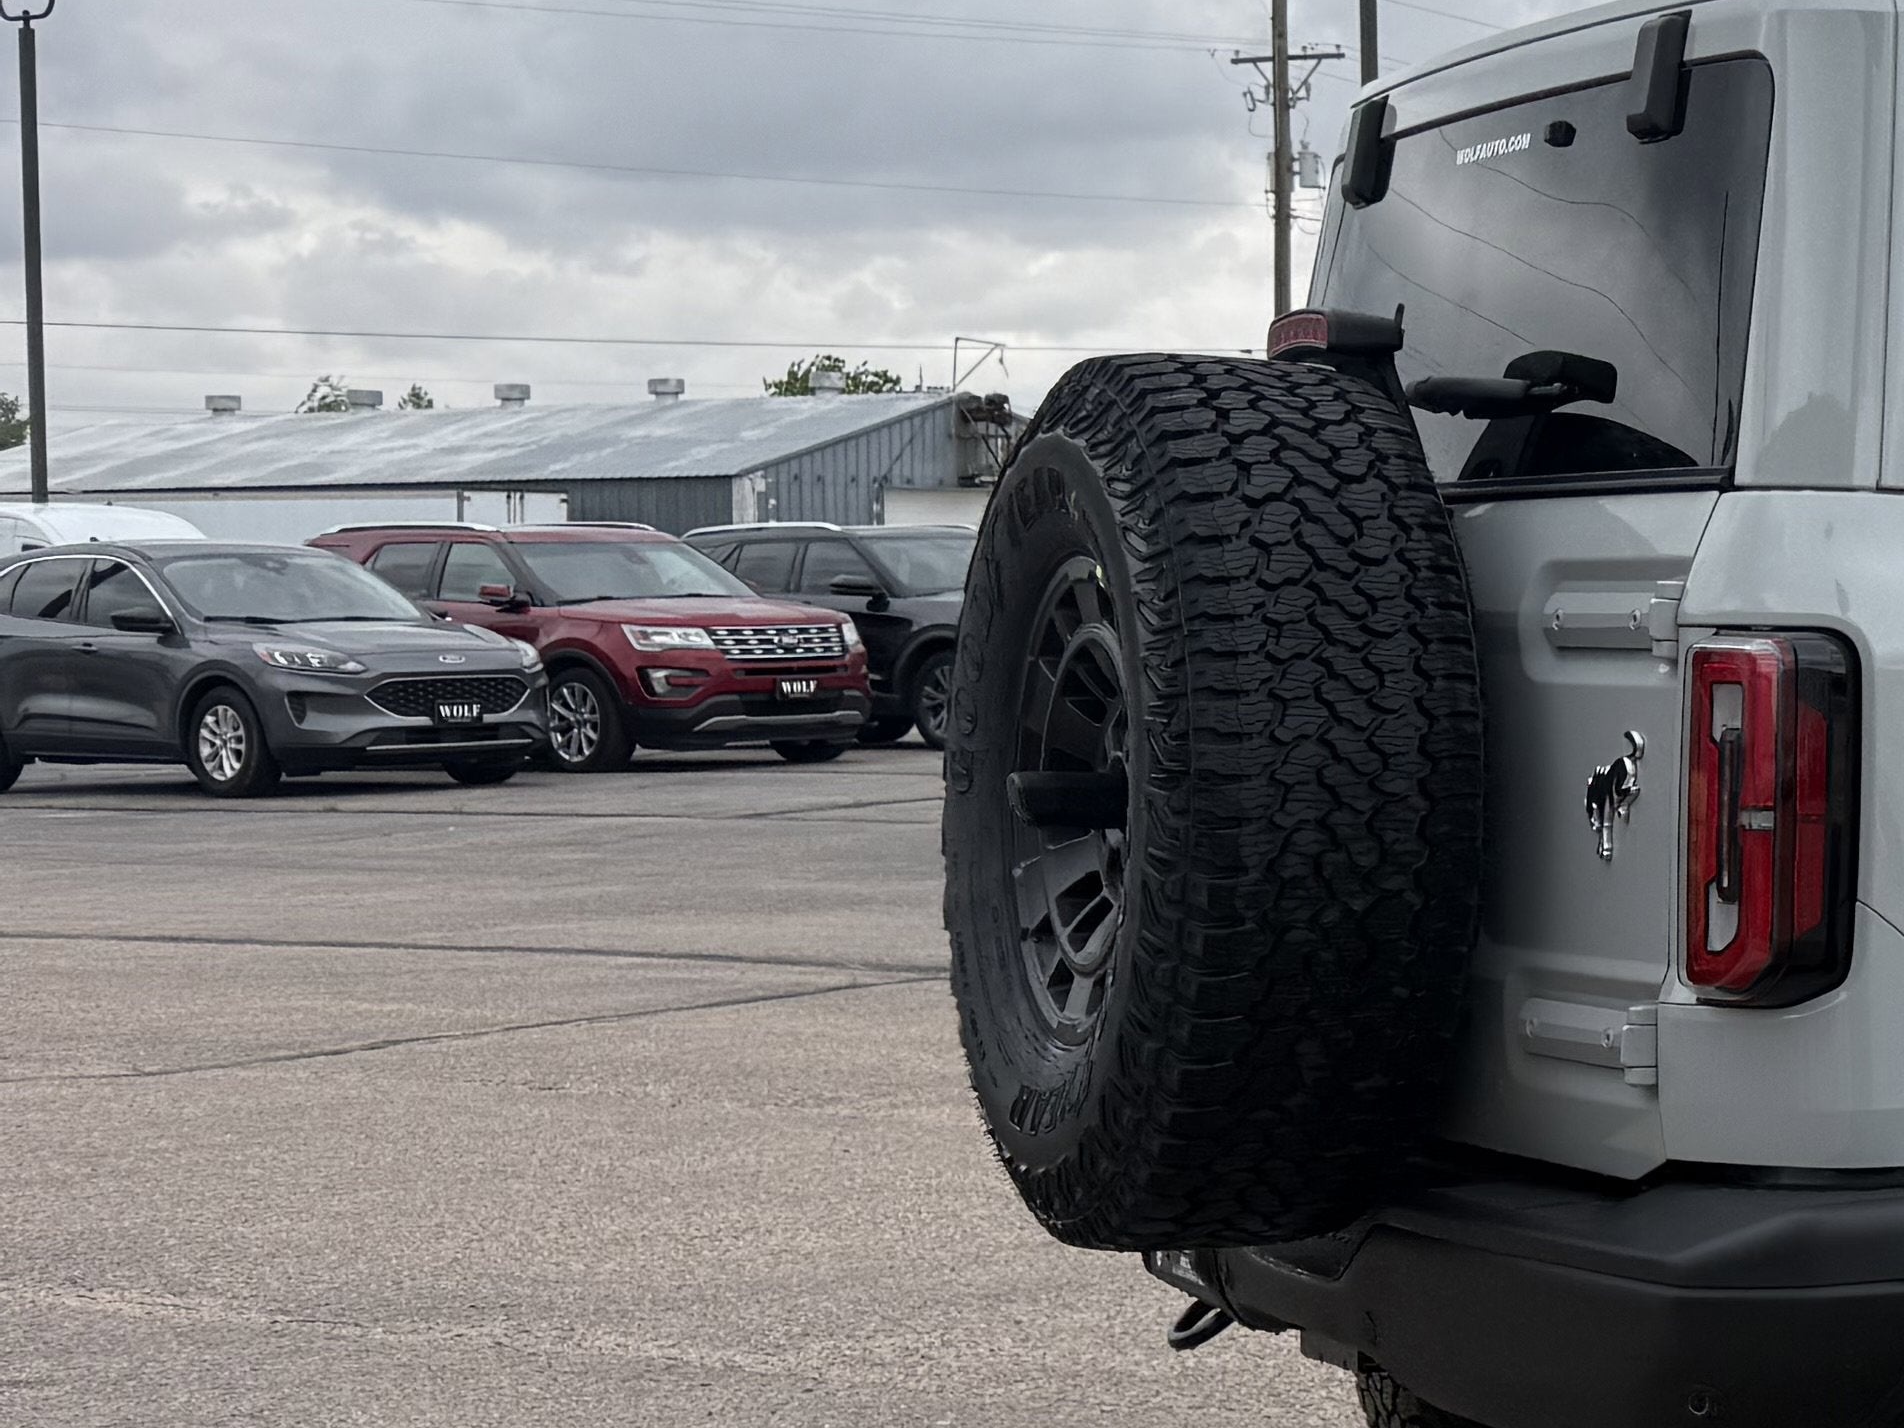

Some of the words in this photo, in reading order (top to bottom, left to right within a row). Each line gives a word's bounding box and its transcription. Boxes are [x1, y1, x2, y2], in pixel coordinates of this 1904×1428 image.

[1456, 133, 1531, 165] WOLFAUTO.COM
[781, 679, 818, 693] WOLF
[439, 703, 481, 718] WOLF
